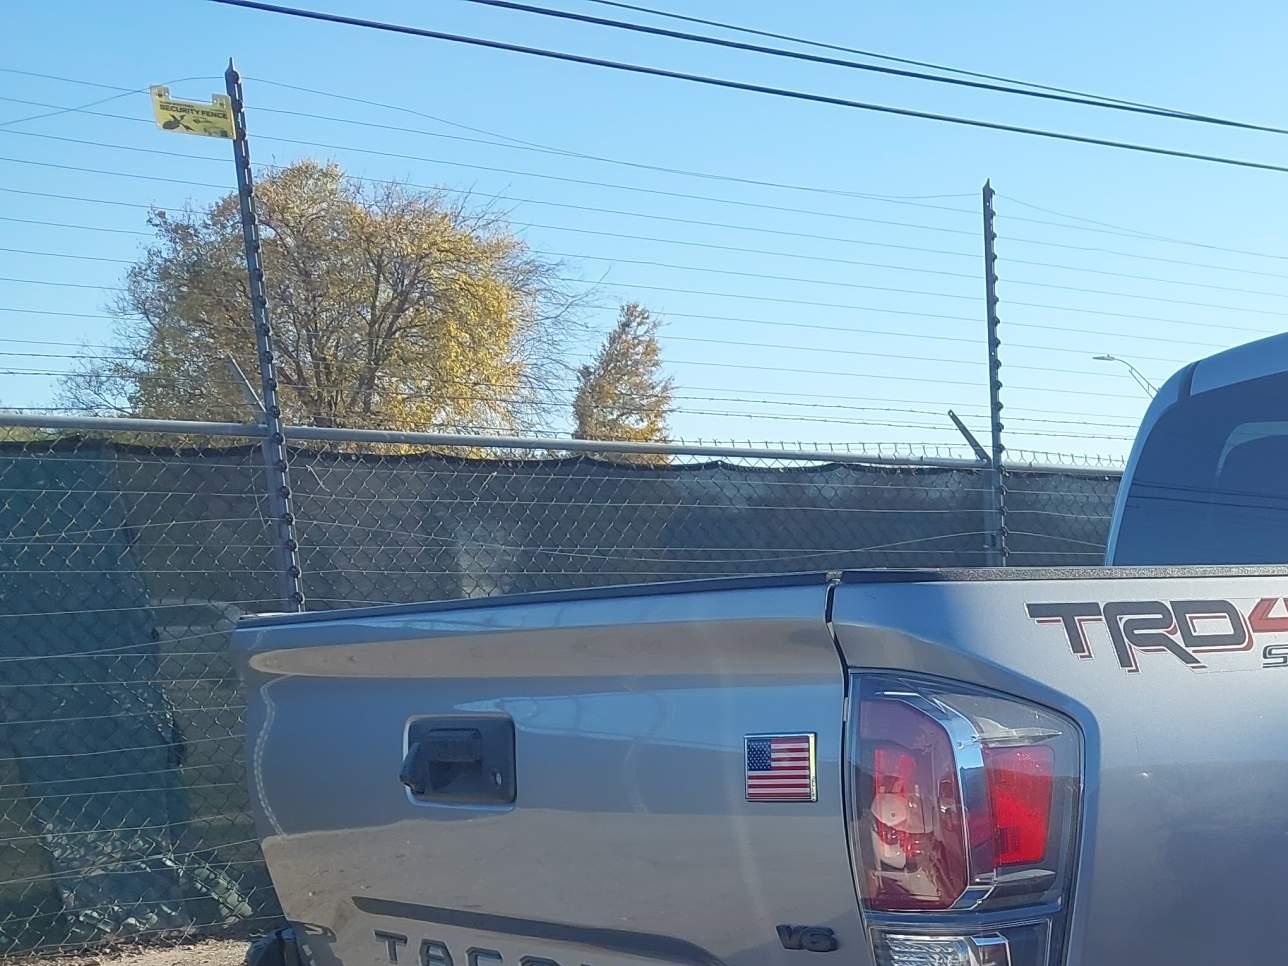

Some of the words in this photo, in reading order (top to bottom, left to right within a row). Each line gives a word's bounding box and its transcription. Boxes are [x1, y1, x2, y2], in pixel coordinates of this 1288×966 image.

[159, 104, 200, 115] SECURITY
[201, 110, 228, 120] FENCE
[1025, 599, 1254, 673] TRD
[775, 924, 839, 953] V6
